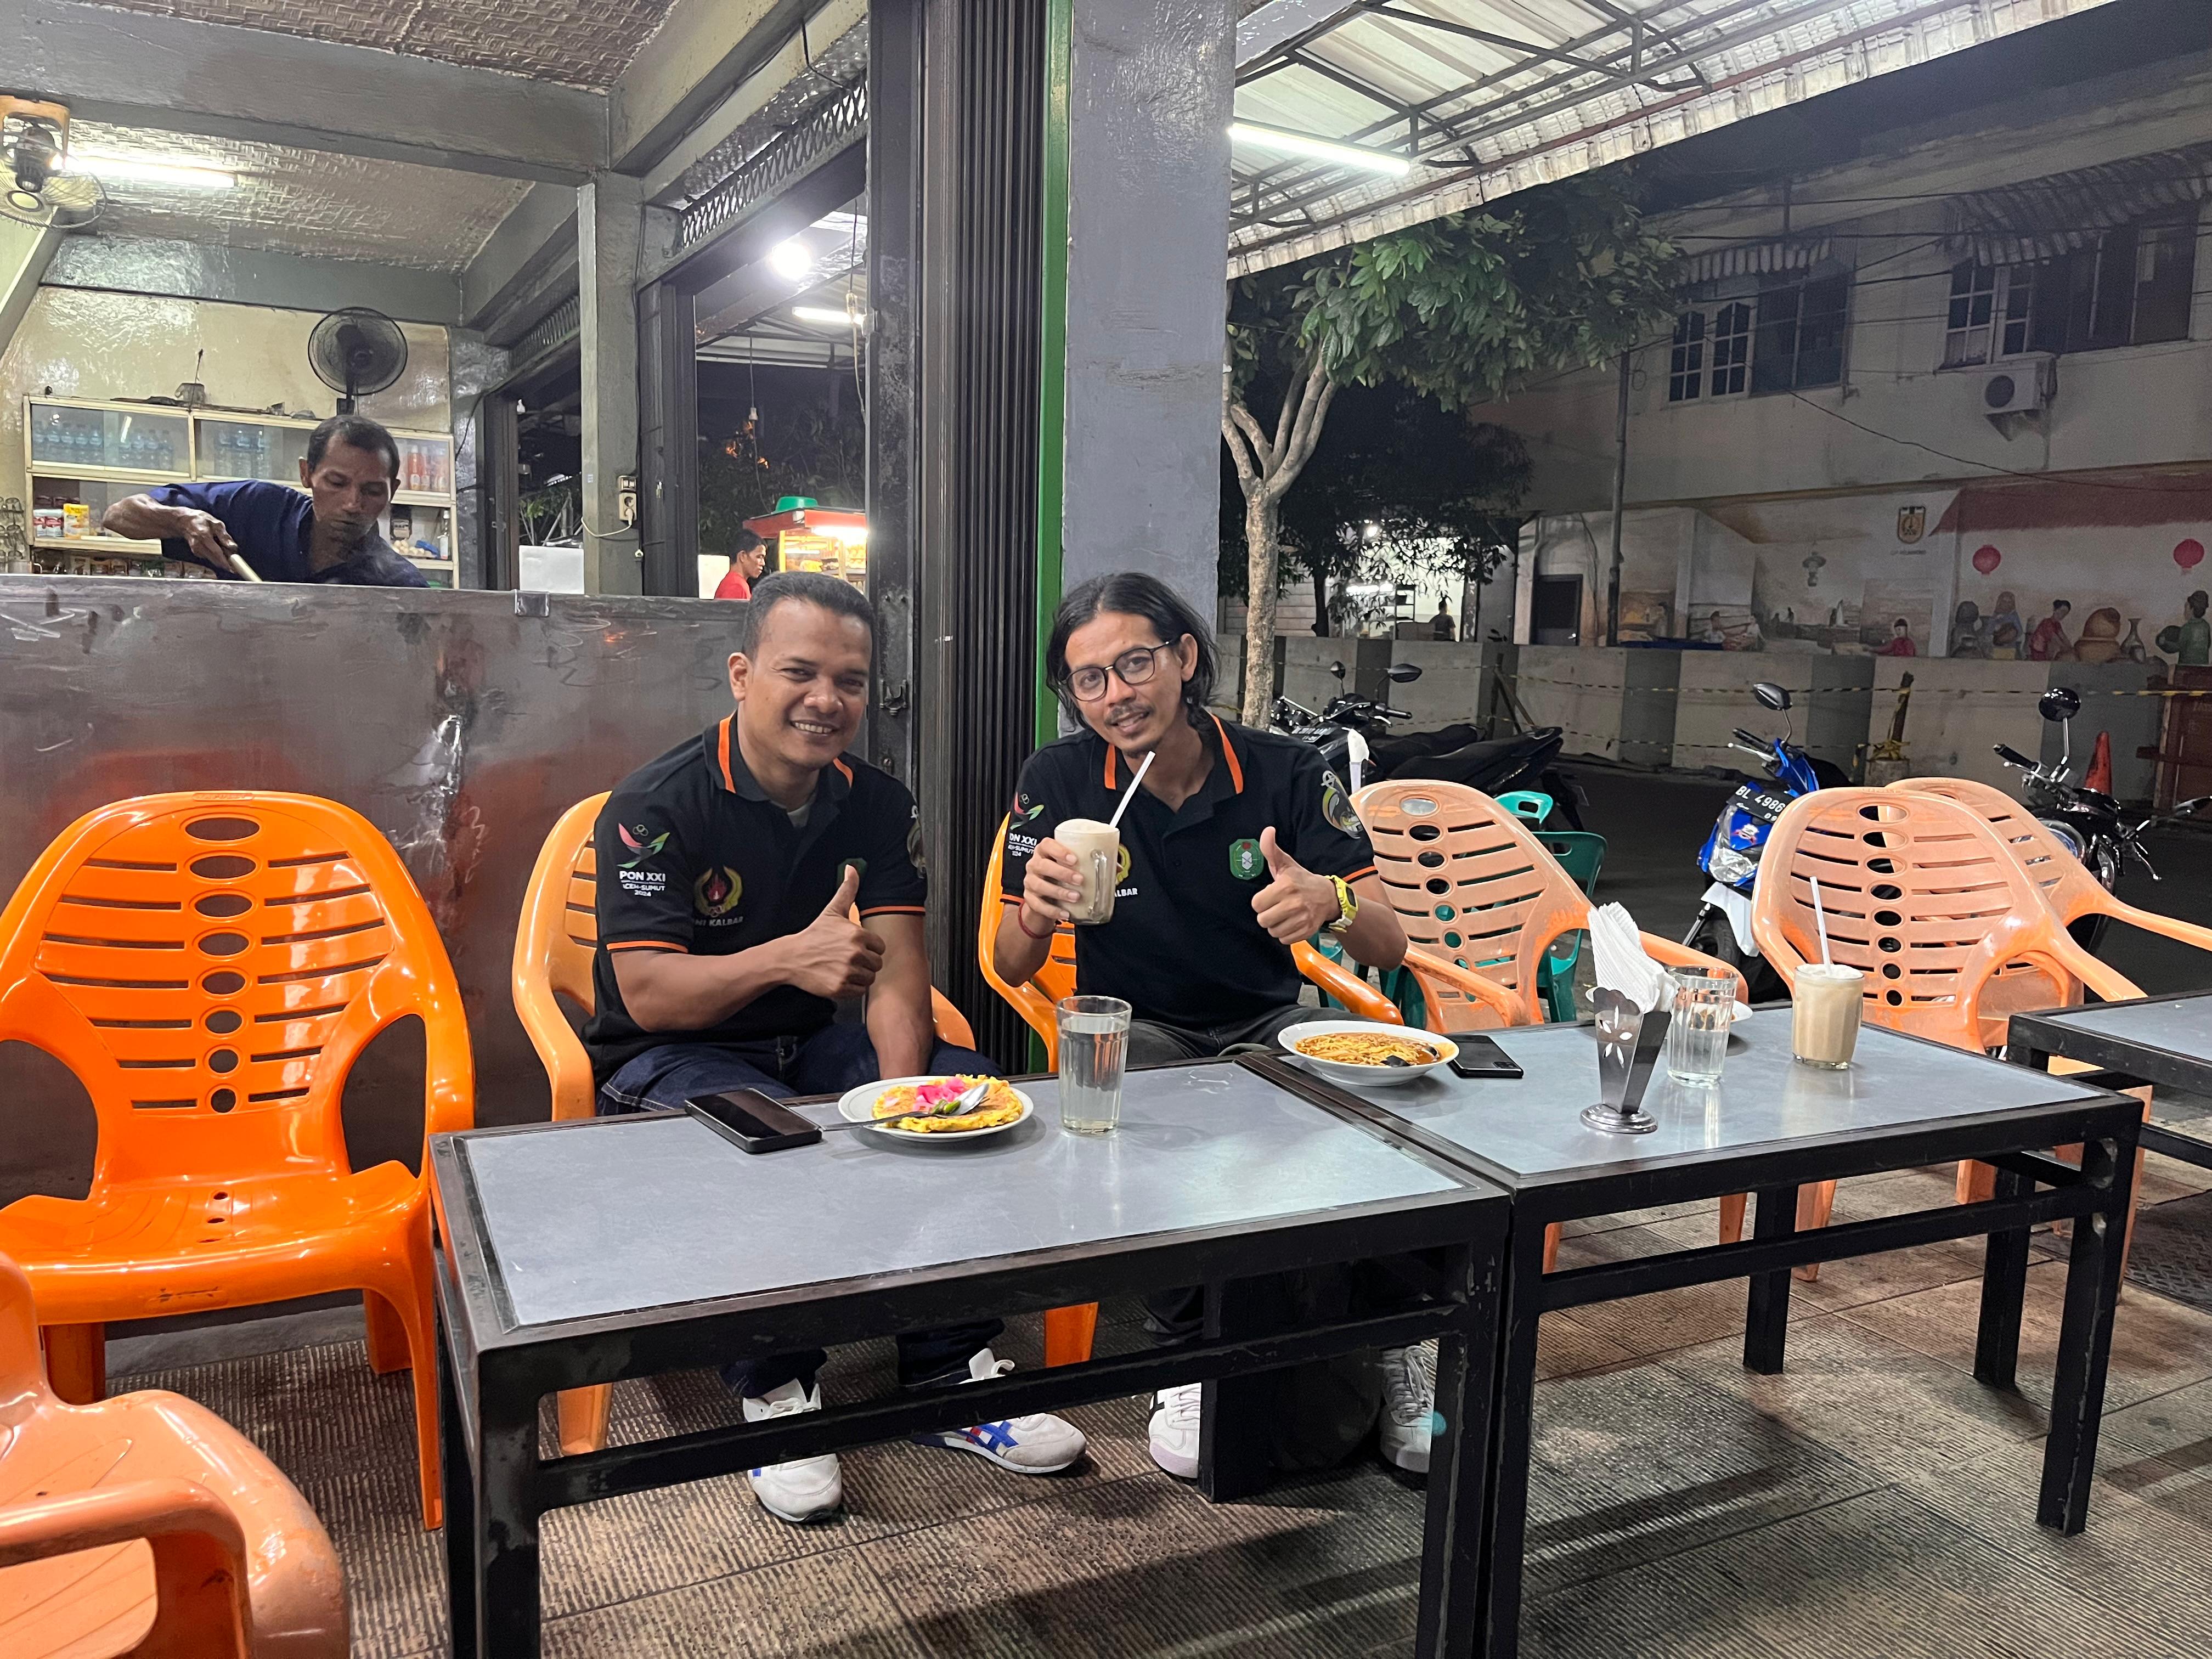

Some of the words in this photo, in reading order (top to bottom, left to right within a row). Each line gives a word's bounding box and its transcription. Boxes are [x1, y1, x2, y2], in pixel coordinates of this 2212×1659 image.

[1735, 786, 1751, 799] BL
[1754, 794, 1786, 812] 4986
[1021, 835, 1037, 846] XXI
[619, 870, 645, 881] PON
[646, 872, 666, 882] XXI
[1114, 888, 1138, 897] LBAR
